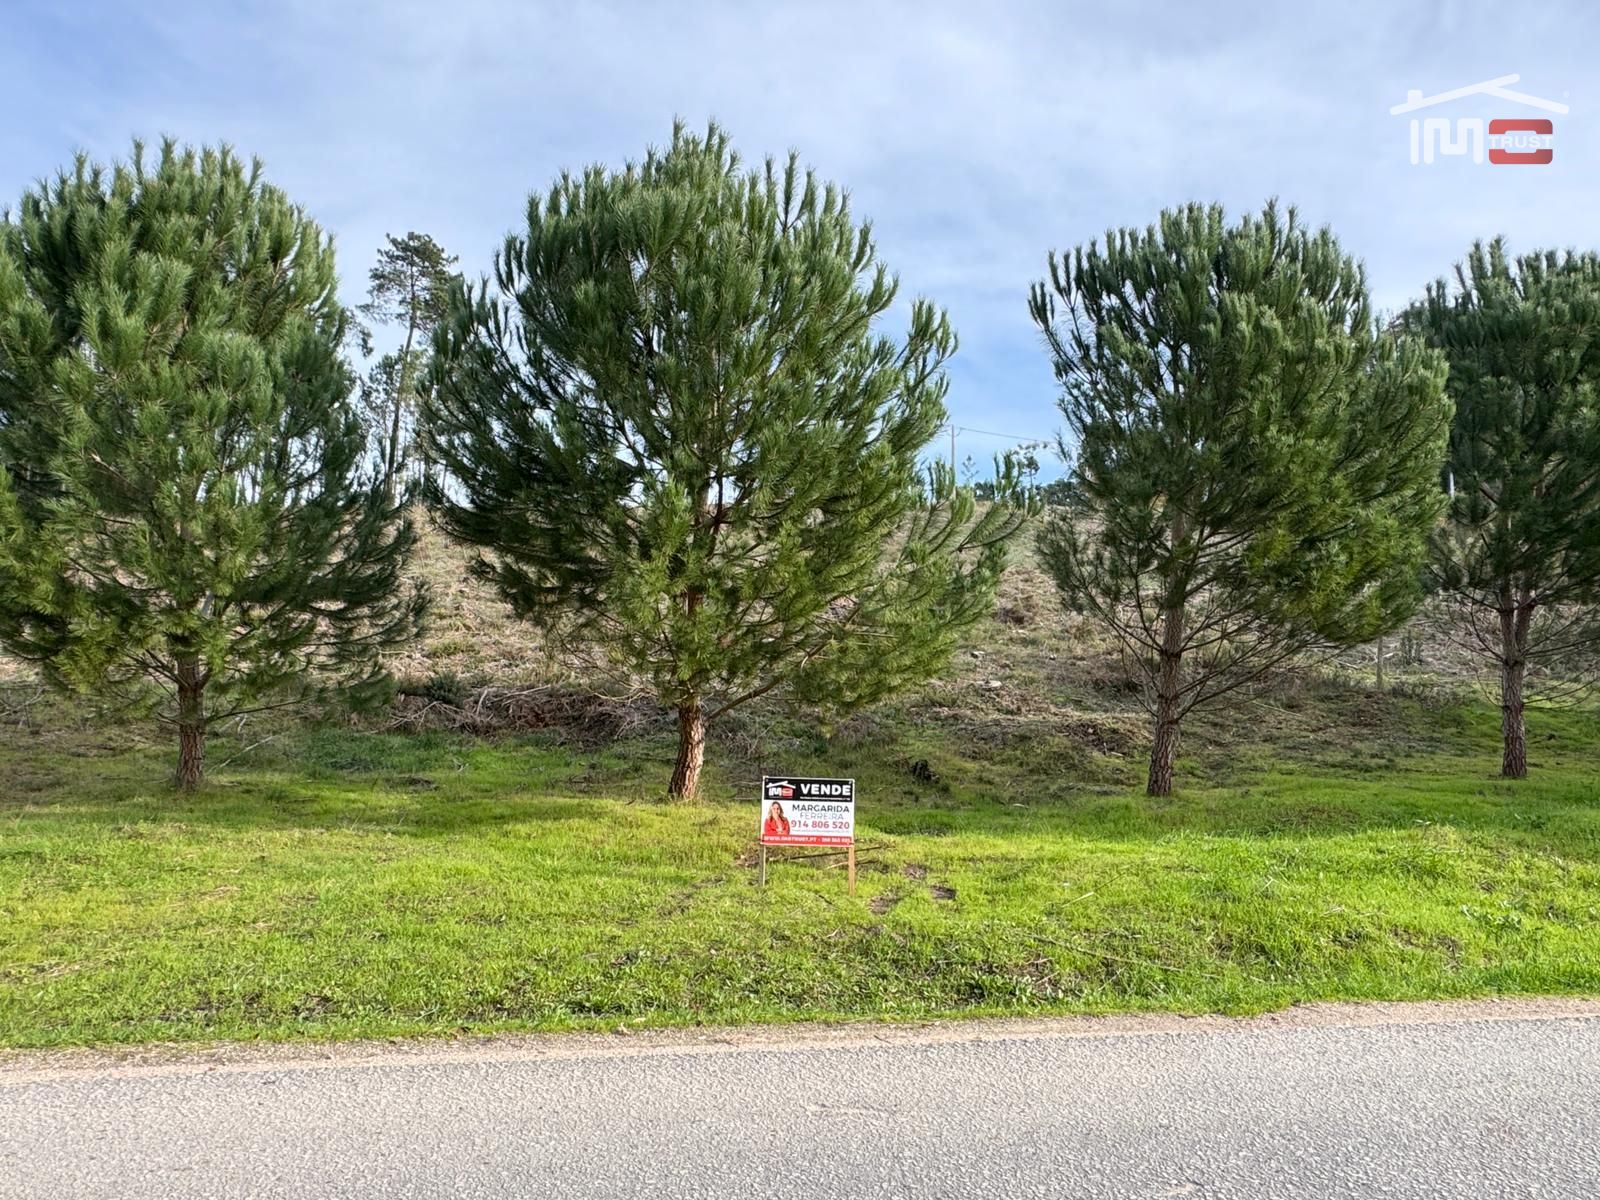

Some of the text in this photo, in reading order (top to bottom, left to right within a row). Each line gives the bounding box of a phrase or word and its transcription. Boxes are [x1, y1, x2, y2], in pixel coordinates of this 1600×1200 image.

[800, 784, 851, 796] VENDE
[792, 804, 849, 812] MARGARIDA
[800, 812, 844, 820] FERREIRA
[791, 820, 850, 829] 914 806 520
